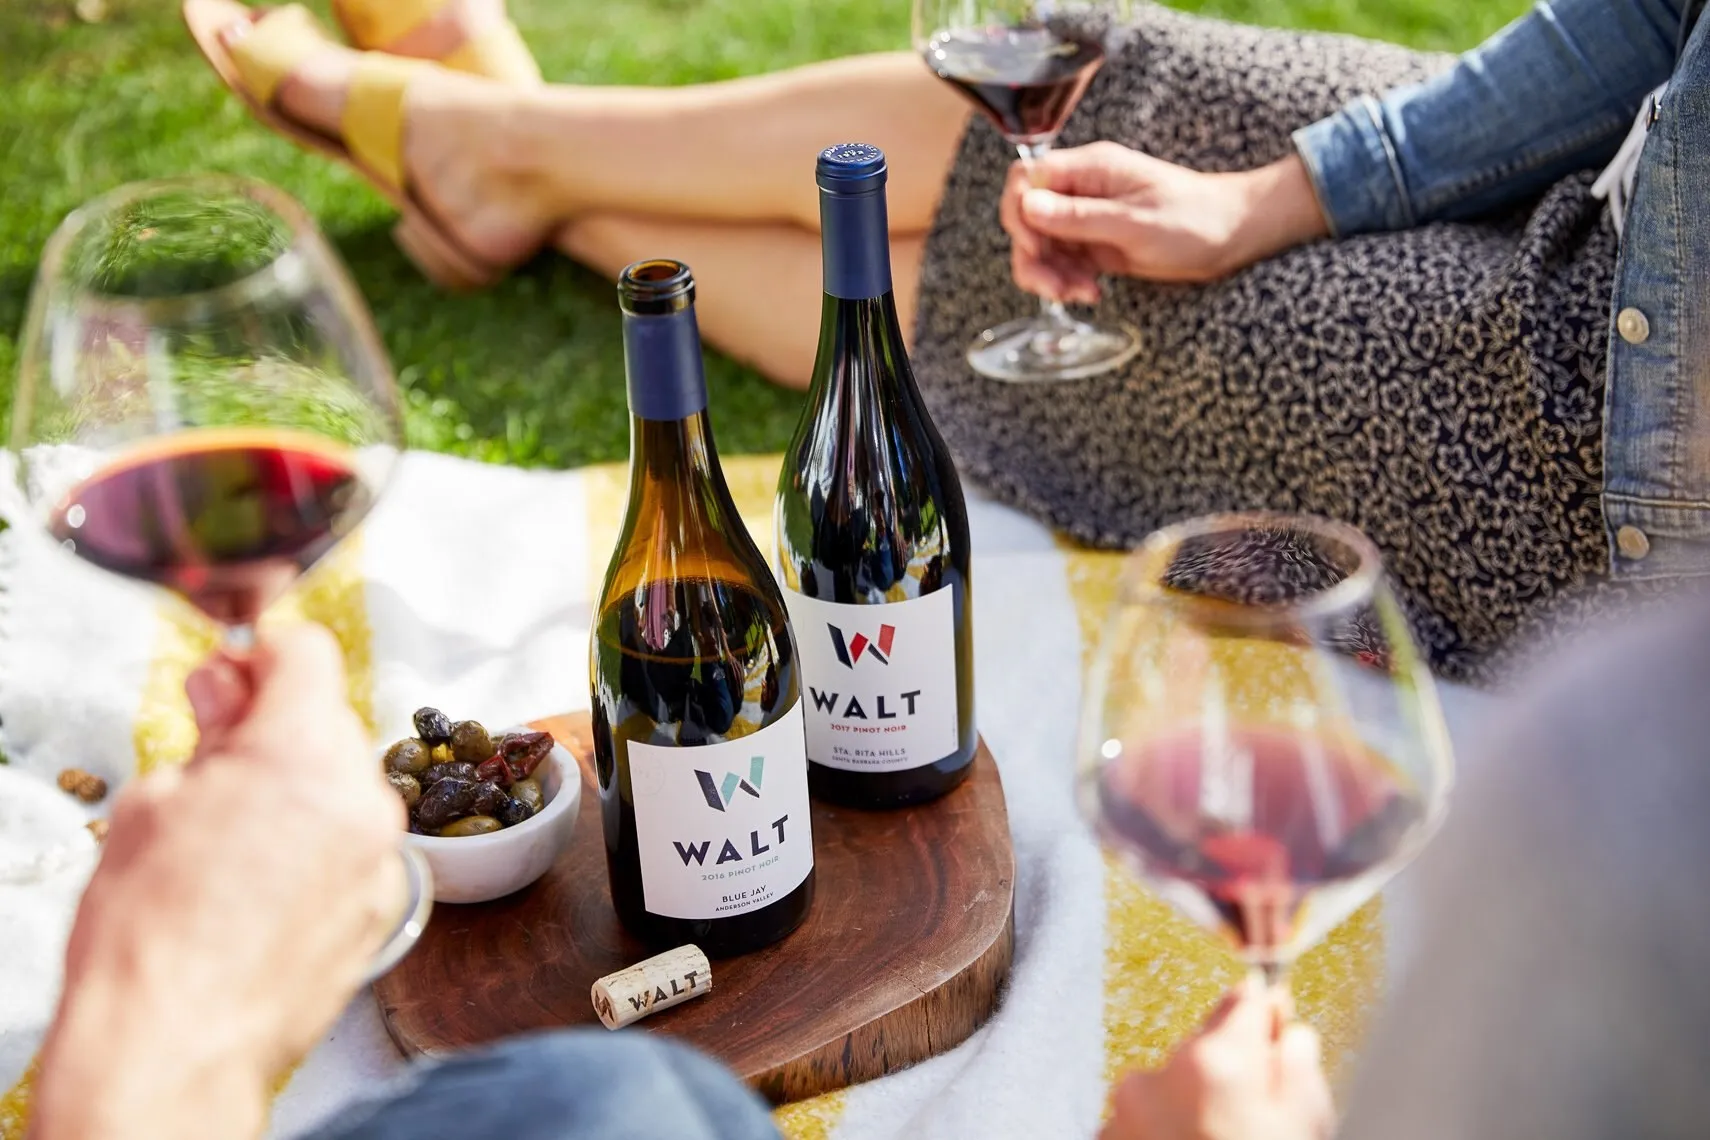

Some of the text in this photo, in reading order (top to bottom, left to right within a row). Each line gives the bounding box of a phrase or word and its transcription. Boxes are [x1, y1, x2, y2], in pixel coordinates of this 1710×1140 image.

[809, 686, 921, 720] WALT
[831, 724, 850, 733] 2017
[884, 725, 907, 733] NOIR
[855, 749, 875, 757] RITA
[879, 748, 905, 756] HILLS
[672, 814, 789, 867] WALT
[728, 865, 756, 878] PINOT
[759, 855, 779, 868] NOIR
[715, 892, 774, 912] ANDERSON VALLEY
[722, 884, 767, 903] BLUE JAY
[628, 970, 698, 1012] WALT
